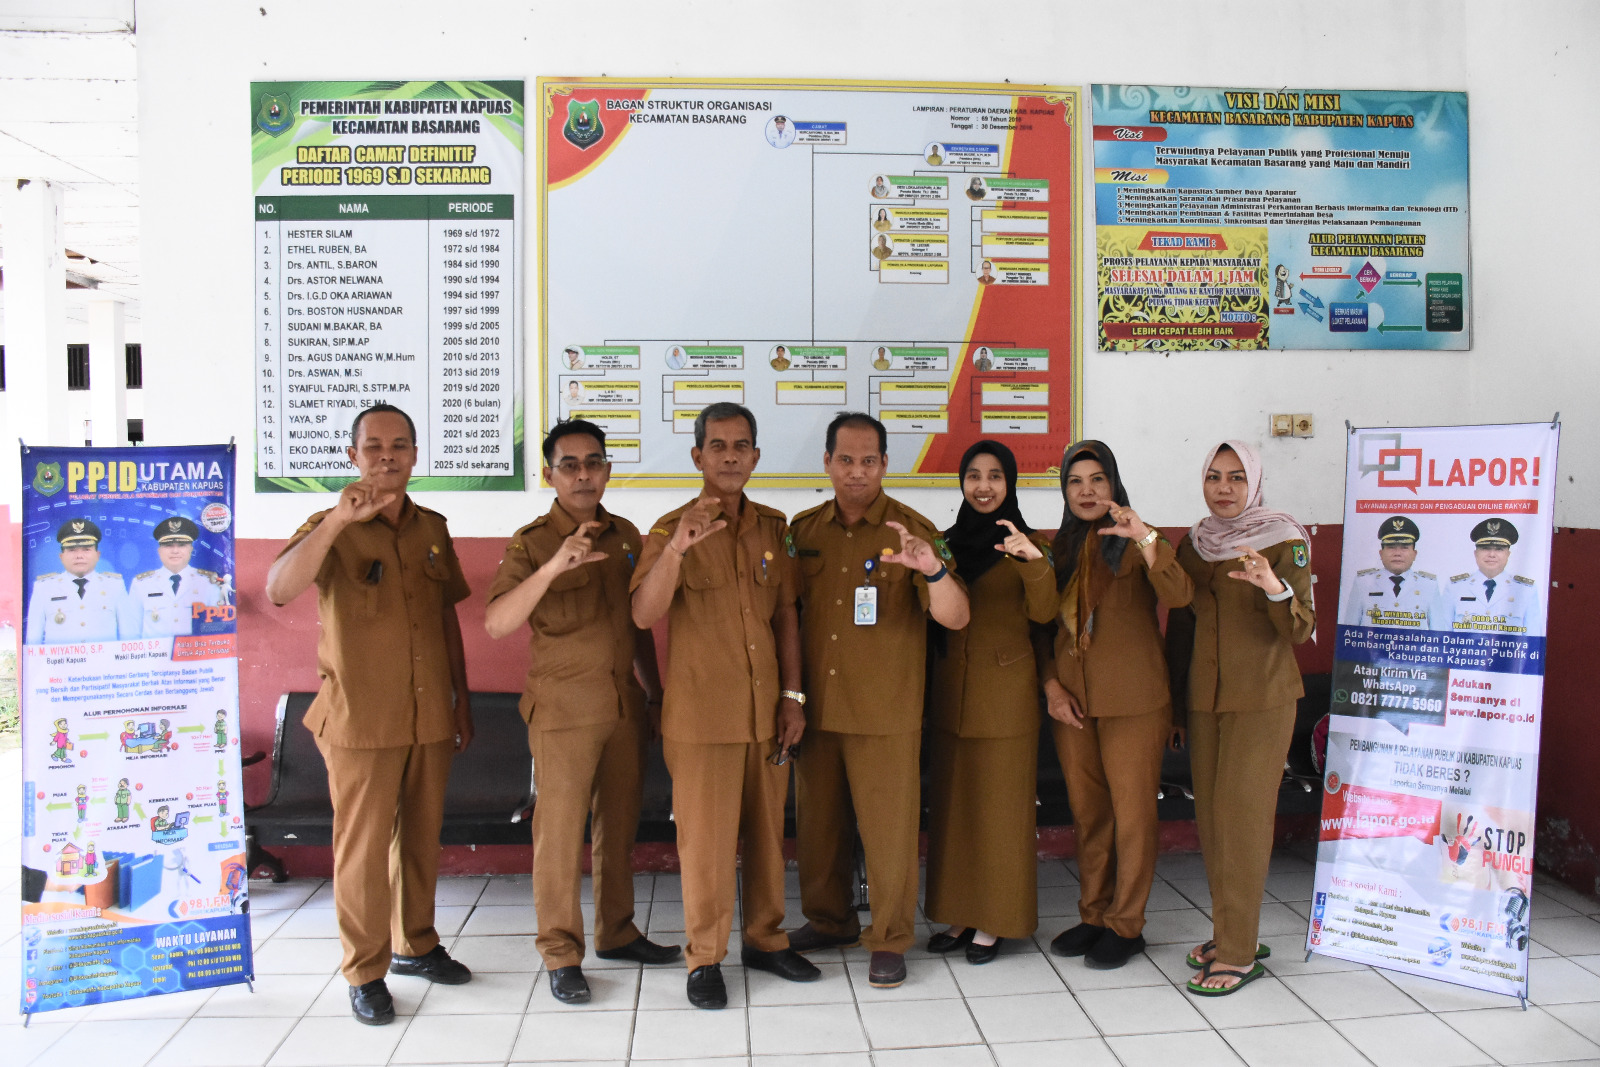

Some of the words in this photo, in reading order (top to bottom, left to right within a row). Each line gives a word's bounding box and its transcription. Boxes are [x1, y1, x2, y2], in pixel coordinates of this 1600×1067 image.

[301, 101, 381, 115] PEMERINTAH
[384, 100, 458, 114] KABUPATEN
[460, 100, 512, 114] KAPUAS
[606, 100, 644, 110] BAGAN
[647, 101, 704, 110] STRUKTUR
[707, 101, 772, 111] ORGANISASI
[1225, 92, 1260, 109] VISI
[1264, 92, 1300, 110] DAN
[1304, 94, 1340, 111] MISI
[629, 114, 689, 124] KECAMATAN
[692, 115, 747, 124] BASARANG
[1150, 110, 1222, 124] KECAMATAN
[1224, 112, 1290, 126] BASARANG
[1293, 113, 1364, 127] KABUPATEN
[1367, 115, 1414, 128] KAPUAS
[332, 121, 409, 134] KECAMATAN
[412, 120, 480, 134] BASARANG
[1113, 128, 1143, 139] Visi
[298, 146, 350, 163] DAFTAR
[355, 146, 405, 163] CAMAT
[409, 146, 475, 162] DEFINITIF
[1156, 147, 1215, 156] Terwujudnya
[1218, 147, 1265, 157] Pelayanan
[1268, 149, 1298, 157] Publik
[1301, 150, 1322, 158] yang
[1325, 150, 1375, 158] Profesional
[1378, 151, 1409, 159] Menuju
[1155, 157, 1208, 166] Masyarakat
[1211, 158, 1262, 167] Kecamatan
[1264, 160, 1306, 168] Basarang
[1333, 160, 1354, 168] Maju
[1357, 160, 1374, 168] dan
[1376, 160, 1409, 169] Mandiri
[282, 168, 341, 185] PERIODE
[345, 168, 382, 184] 1969
[387, 168, 411, 184] S.D
[415, 167, 491, 184] SEKARANG
[1111, 170, 1148, 182] Misi
[259, 203, 277, 214] NO.
[339, 203, 369, 213] NAMA
[448, 202, 494, 213] PERIODE
[264, 230, 271, 238] 1.
[287, 230, 323, 238] HESTER
[325, 230, 352, 238] SILAM
[443, 229, 463, 238] 1969
[480, 229, 500, 238] 1972
[1309, 233, 1336, 244] ALUR
[1337, 234, 1393, 245] PELAYANAN
[1395, 235, 1425, 245] PATEN
[1152, 237, 1182, 247] TEKAD
[1185, 238, 1210, 247] KAMI
[264, 246, 271, 254] 2.
[287, 245, 316, 254] ETHEL
[318, 245, 352, 255] RUBEN,
[354, 245, 367, 254] BA
[443, 245, 463, 253] 1972
[465, 244, 478, 253] s/d
[480, 244, 500, 253] 1984
[1311, 246, 1369, 256] KECAMATAN
[1370, 246, 1423, 257] BASARANG
[1103, 258, 1133, 266] PROSES
[1135, 258, 1178, 267] PELAYANAN
[1180, 258, 1210, 267] KEPADA
[1212, 258, 1261, 267] MASYARAKAT
[1111, 269, 1163, 282] SELESAI
[1168, 270, 1213, 282] DALAM
[1218, 271, 1224, 282] 1
[1228, 270, 1254, 283] JAM
[1132, 327, 1157, 335] LEBIH
[262, 384, 275, 392] 11.
[288, 384, 325, 393] SYAIFUL
[327, 384, 361, 394] FADJRI,
[443, 384, 463, 392] 2019
[465, 383, 478, 392] s/d
[480, 383, 500, 392] 2020
[264, 415, 275, 424] 13.
[289, 415, 314, 425] YAYA,
[315, 415, 327, 424] SP
[443, 415, 463, 423] 2020
[465, 414, 478, 423] s/d
[480, 414, 499, 423] 2021
[67, 461, 137, 493] PPID
[140, 462, 223, 480] UTAMA
[1428, 457, 1540, 487] LAPOR!
[142, 482, 190, 491] KABUPATEN
[192, 482, 223, 490] KAPUAS
[1344, 630, 1363, 638] Ada
[1367, 631, 1439, 643] Permasalahan
[1443, 636, 1474, 645] Dalam
[1478, 638, 1528, 650] Jalannya
[28, 648, 36, 656] H.
[39, 647, 48, 656] M.
[50, 646, 88, 655] WIYATNO,
[91, 645, 104, 654] S.P.
[121, 642, 146, 652] DODO,
[148, 641, 161, 649] S.P.
[1344, 639, 1417, 651] Pembangunan
[1420, 644, 1439, 653] dan
[1443, 646, 1487, 656] Layanan
[1492, 649, 1526, 659] Publik
[1530, 651, 1539, 660] di
[1388, 652, 1443, 662] Kabupaten
[1447, 656, 1493, 666] Kapuas?
[1354, 665, 1378, 676] Atau
[1381, 668, 1408, 678] Kirim
[1411, 669, 1427, 680] Via
[1363, 679, 1416, 695] WhatsApp
[1451, 678, 1492, 690] Adukan
[1351, 692, 1378, 706] 0821
[1381, 694, 1409, 708] 7777
[1412, 698, 1442, 712] 5960
[1451, 692, 1506, 707] Semuanya
[1510, 698, 1520, 707] di
[1450, 708, 1535, 723] www.lapor.go.id
[1394, 761, 1423, 777] TIDAK
[1426, 765, 1460, 781] BERES
[1321, 810, 1435, 832] www.lapor.go.id
[1484, 826, 1526, 855] STOP
[156, 934, 191, 948] WAKTU
[195, 928, 237, 943] LAYANAN
